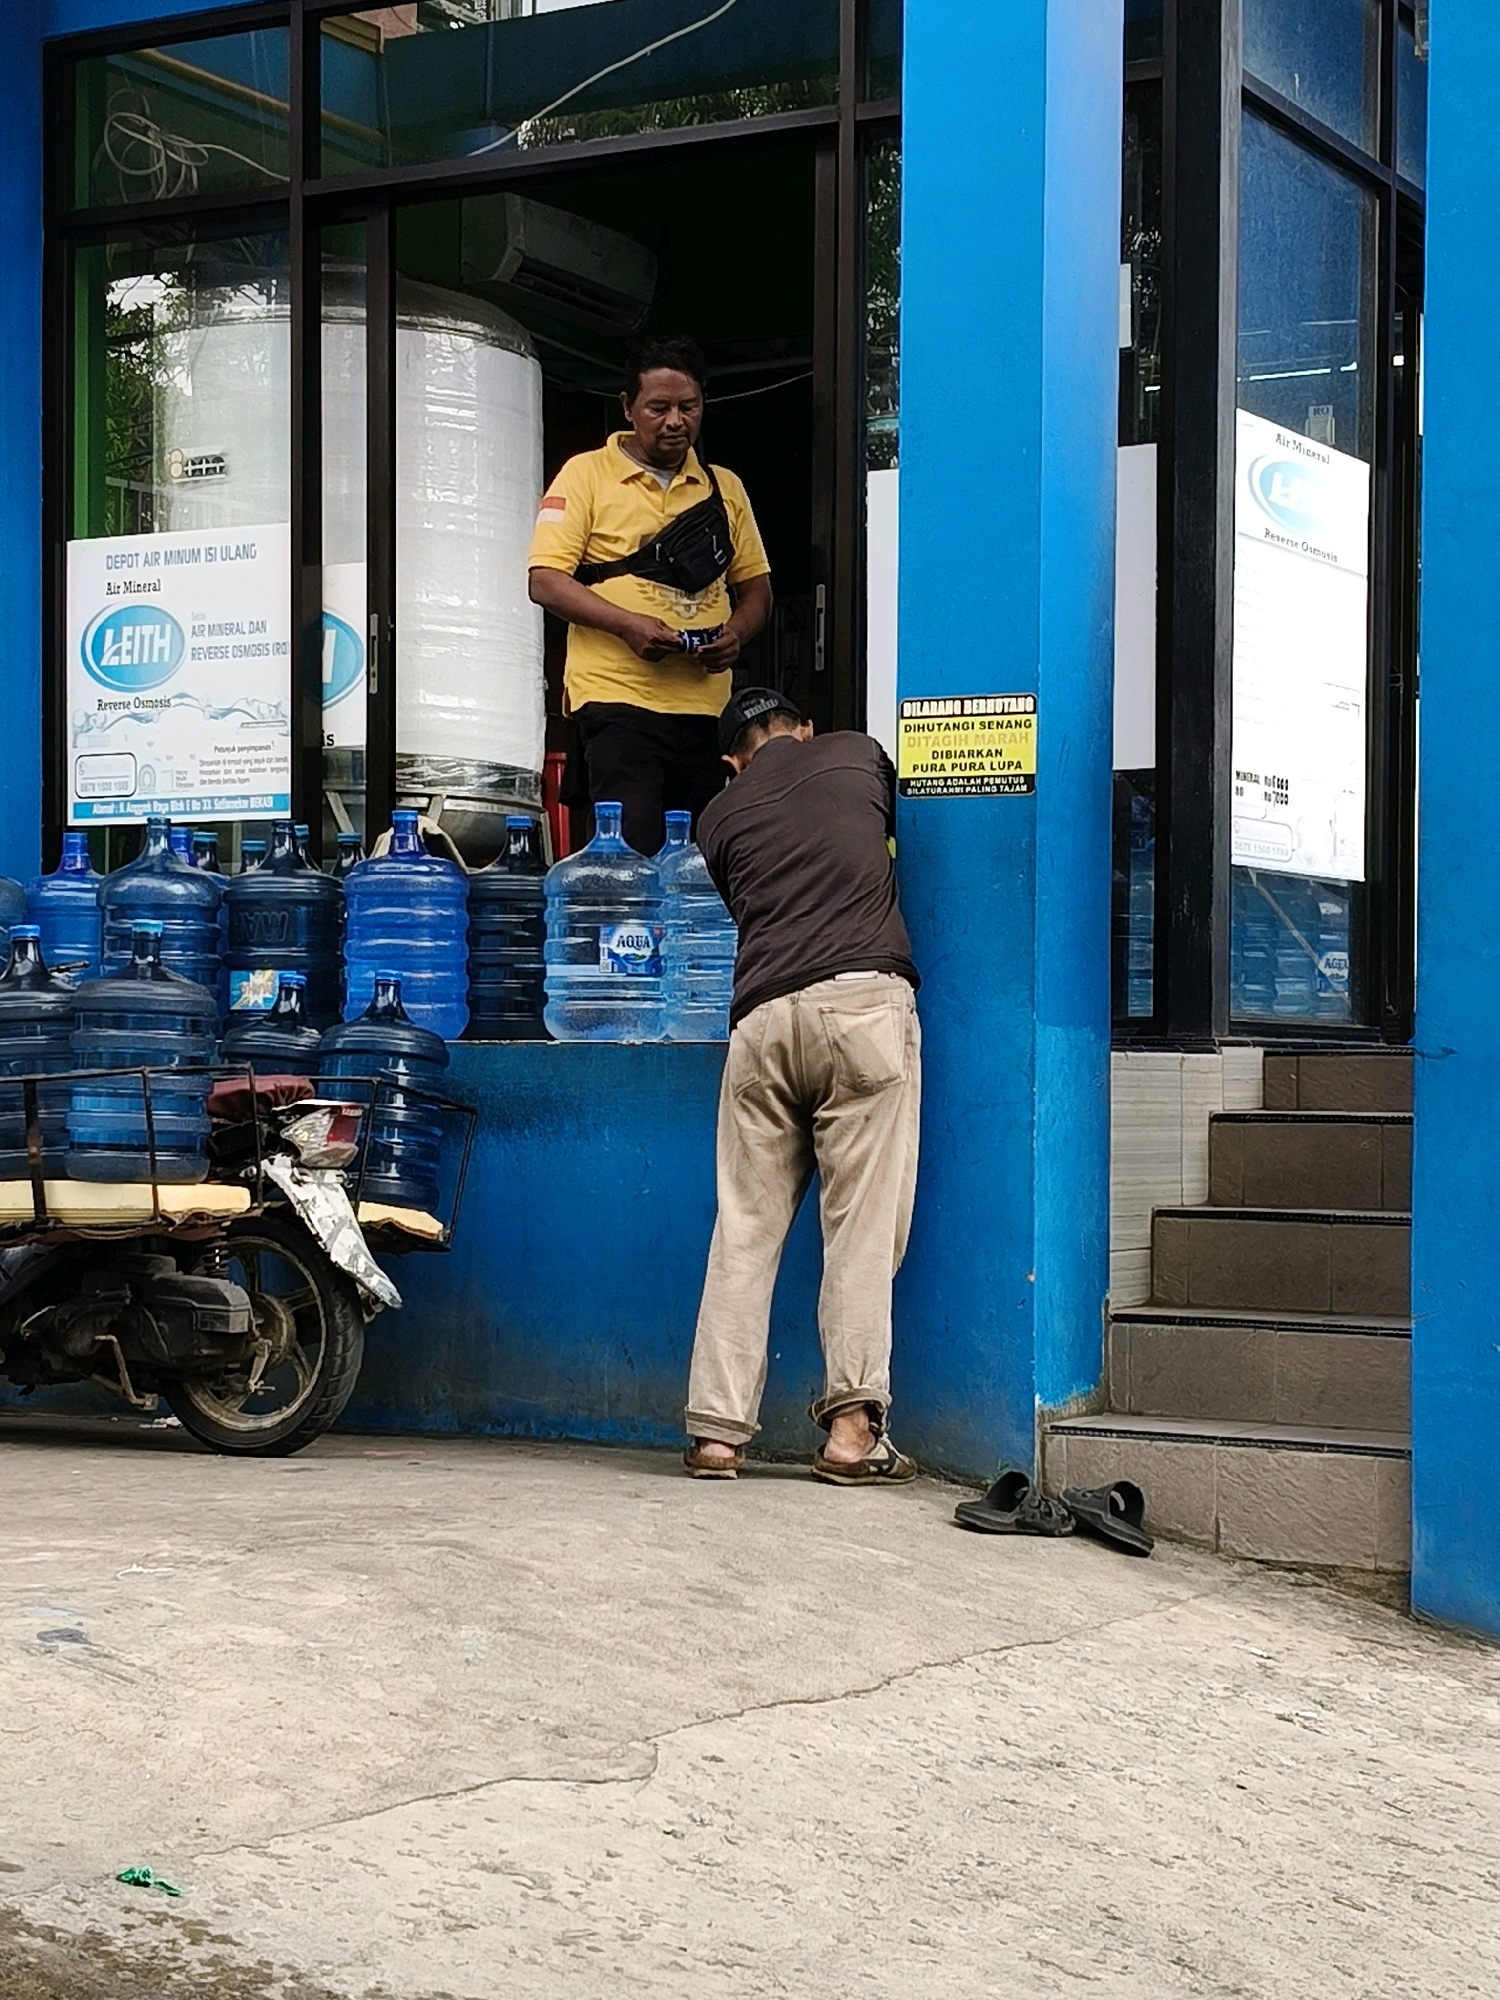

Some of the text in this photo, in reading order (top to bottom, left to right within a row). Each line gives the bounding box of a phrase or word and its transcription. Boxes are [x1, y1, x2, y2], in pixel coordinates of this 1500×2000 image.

[1313, 407, 1330, 415] RO
[1275, 433, 1330, 464] Air Mineral
[1264, 527, 1300, 549] Reverse
[1301, 541, 1338, 563] Osmosis
[106, 543, 257, 570] DEPOT AIR MINUM ISI ULANG
[106, 579, 162, 596] Air Mineral
[191, 620, 267, 638] AIR MINERAL DAN
[100, 624, 172, 666] LEITH
[191, 645, 230, 661] REVERSE
[232, 643, 270, 658] OSMOSIS
[97, 694, 172, 711] Reverse Osmosis
[903, 696, 1034, 717] DILARANG BERHUTANG
[904, 719, 1032, 733] DIHUTANGI SENANG
[907, 732, 1029, 748] DITAGIH MARAH
[932, 749, 1003, 760] DIBIARKAN
[912, 761, 1022, 773] PURA PURA LUPA
[906, 784, 1028, 795] SILATURAHMI PALING TAJAM
[910, 776, 1025, 787] HUTANG ADALAH PEMUTUS
[616, 935, 650, 950] AQUA
[1324, 957, 1348, 972] AQU
